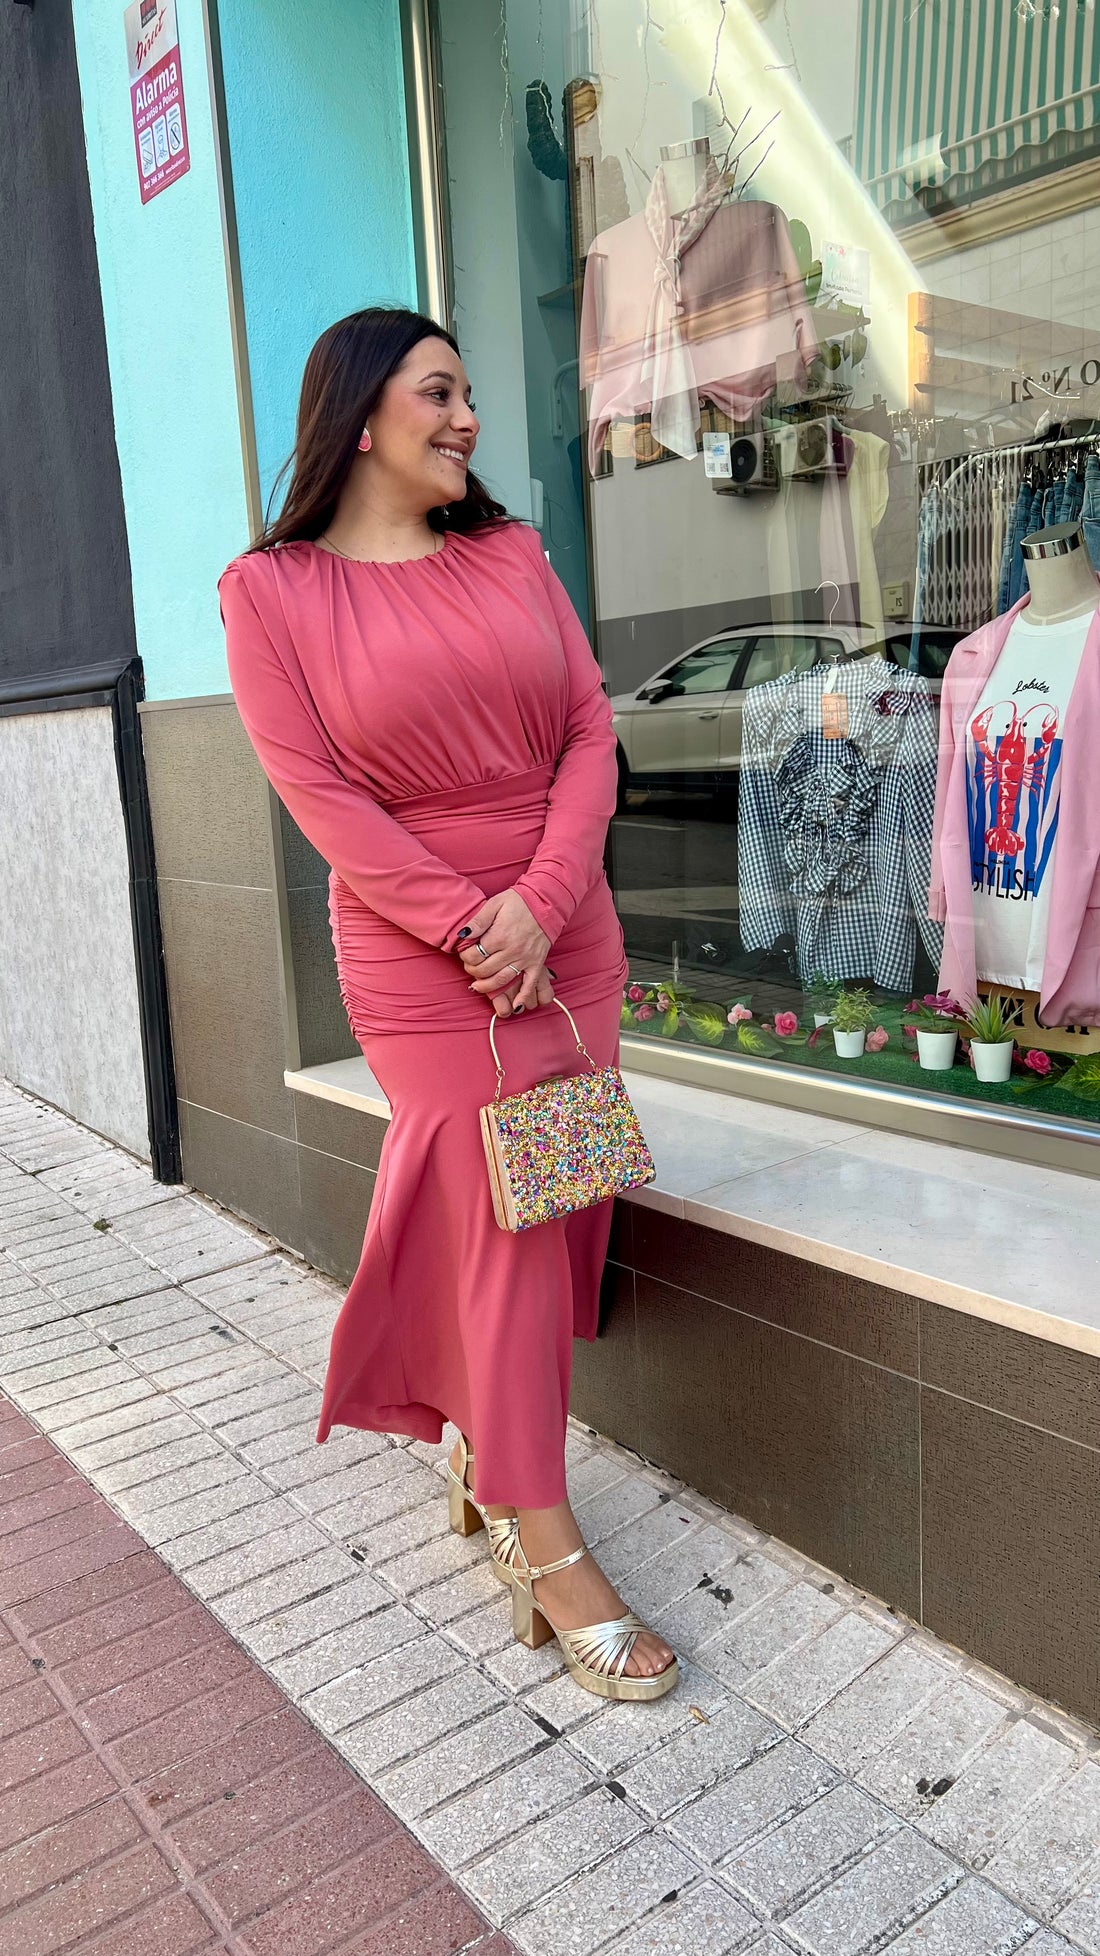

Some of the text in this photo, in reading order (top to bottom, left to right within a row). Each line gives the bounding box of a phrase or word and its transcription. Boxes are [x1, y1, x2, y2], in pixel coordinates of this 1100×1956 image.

[135, 7, 167, 69] Direct
[136, 62, 177, 115] Alarma
[137, 116, 146, 129] con
[146, 105, 158, 121] aviso
[1012, 678, 1050, 695] Lobster
